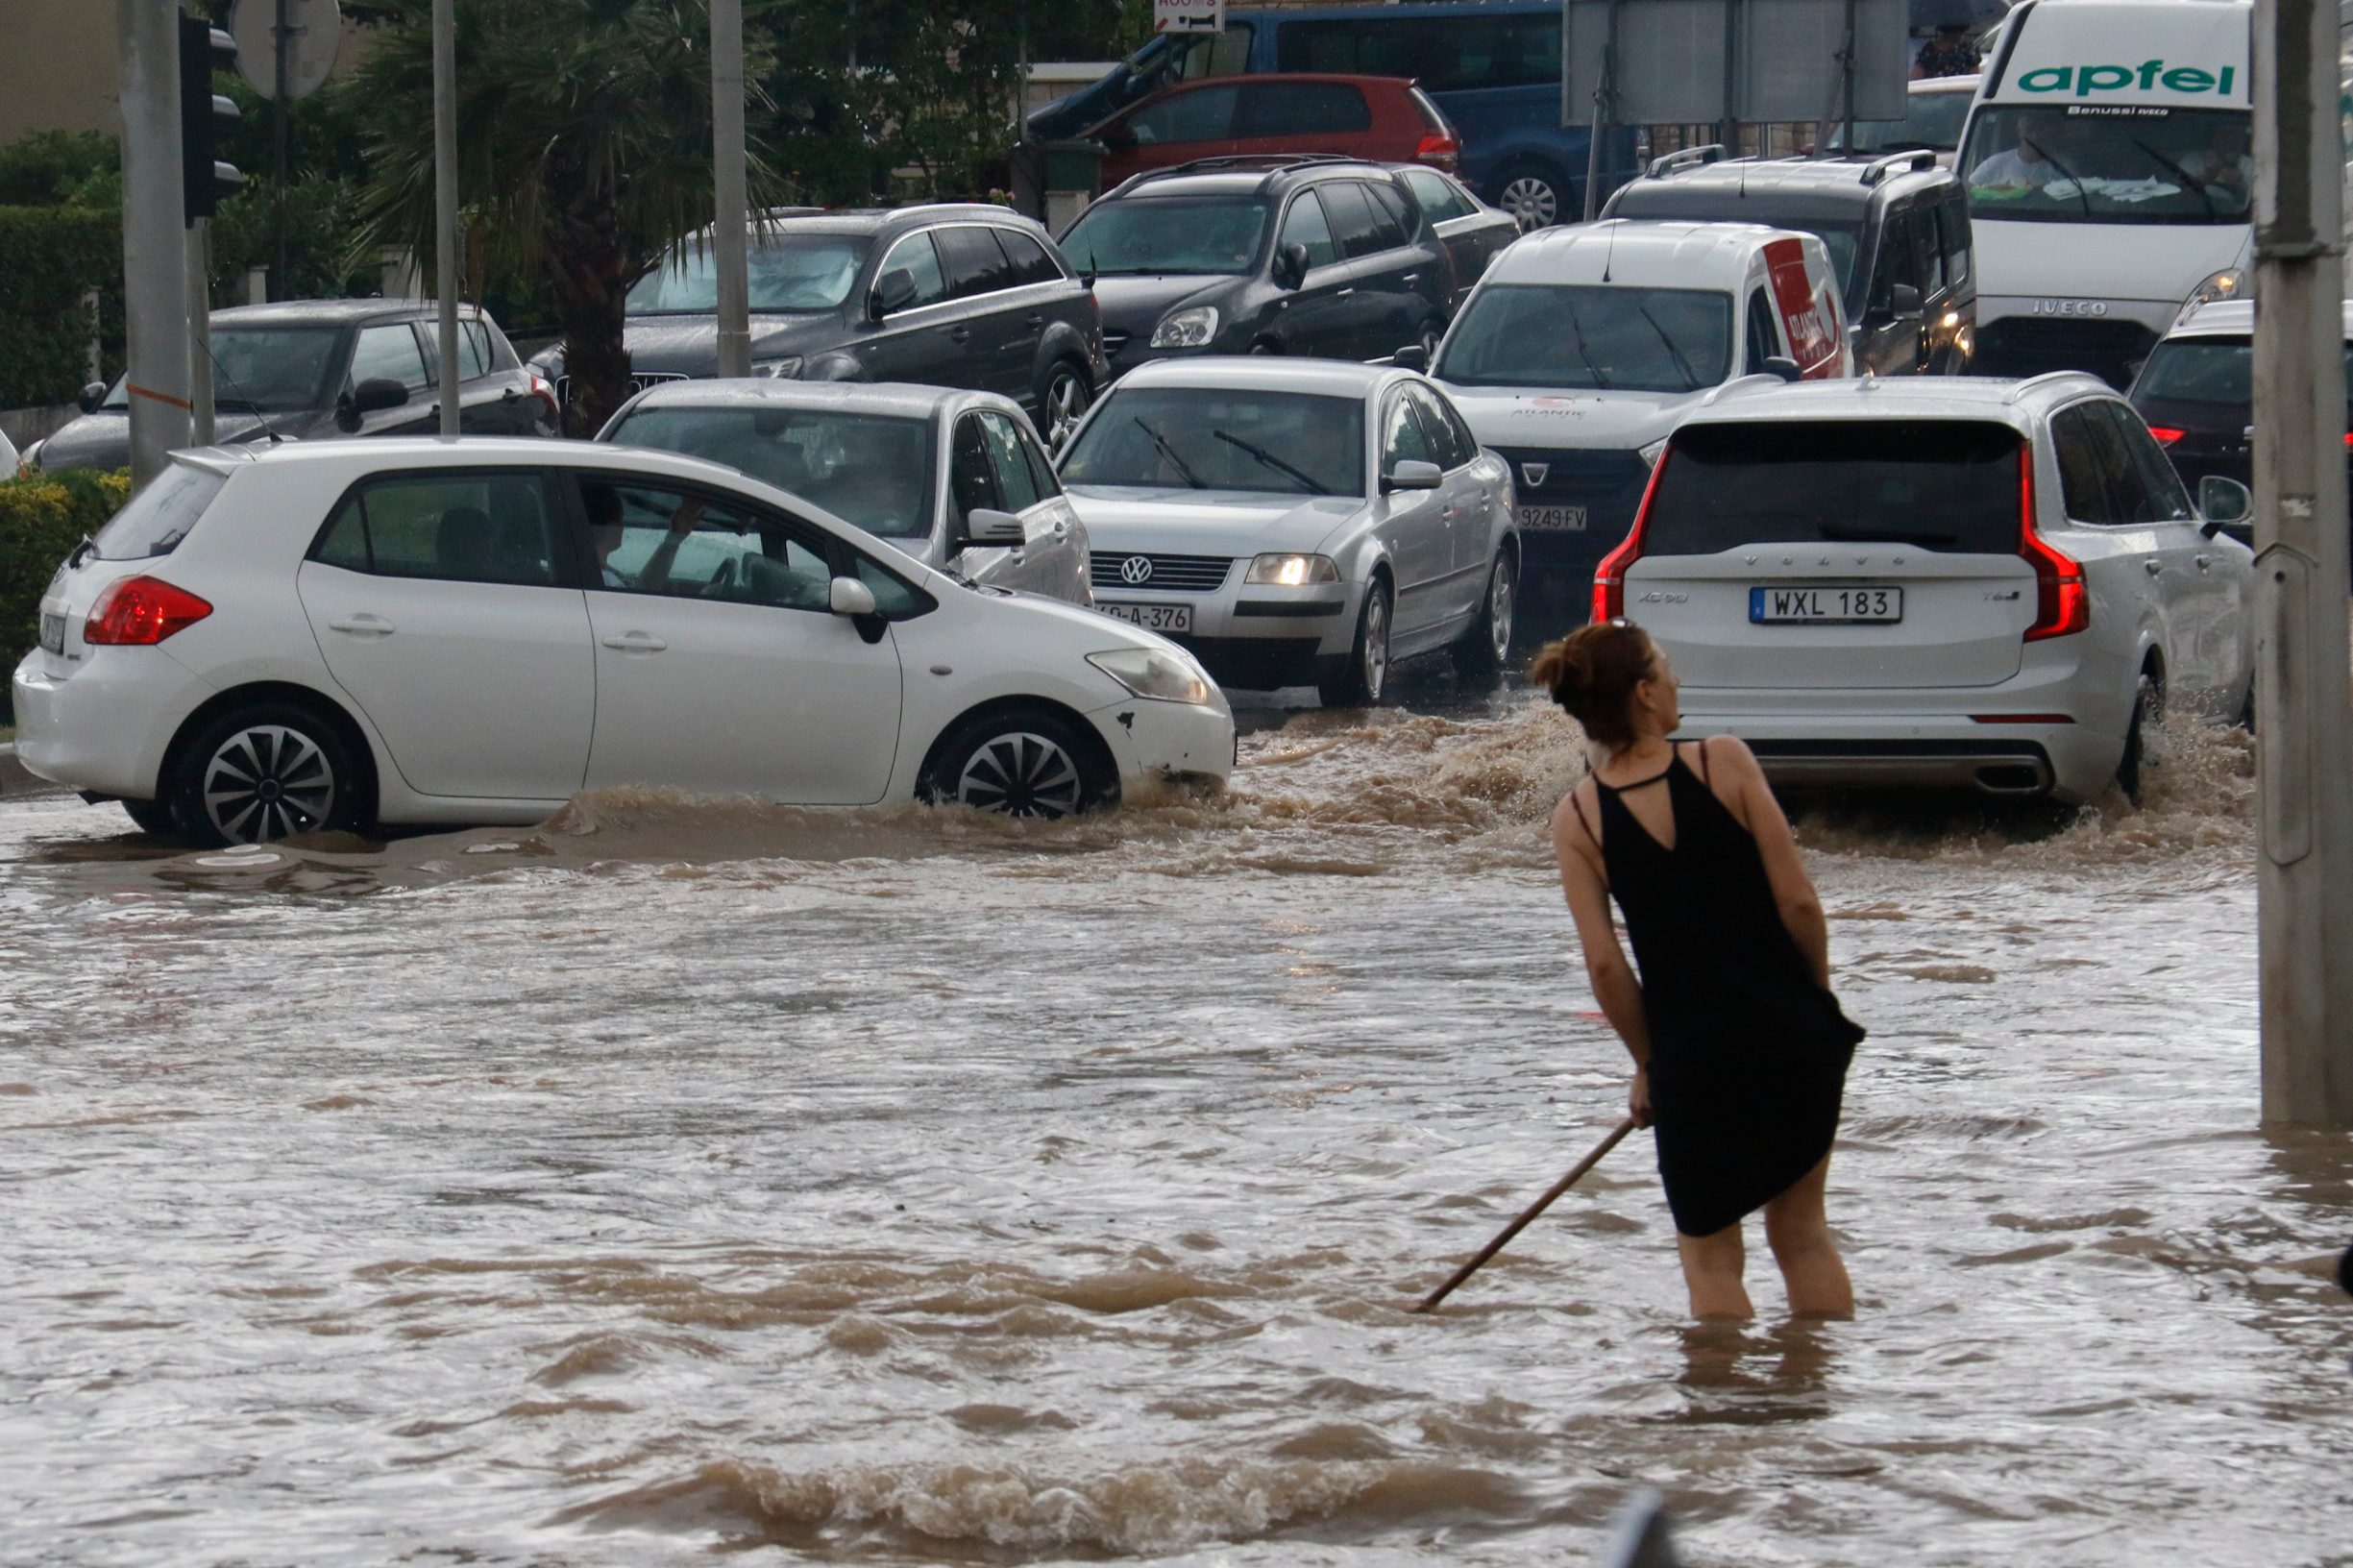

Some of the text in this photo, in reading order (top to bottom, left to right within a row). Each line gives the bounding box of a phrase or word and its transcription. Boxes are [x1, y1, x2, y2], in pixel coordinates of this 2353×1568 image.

[2018, 60, 2235, 96] apfel
[2068, 106, 2136, 114] Benussi
[2033, 300, 2108, 316] IVECO
[1744, 555, 1905, 566] VOLVO
[1775, 592, 1888, 615] WXL 183
